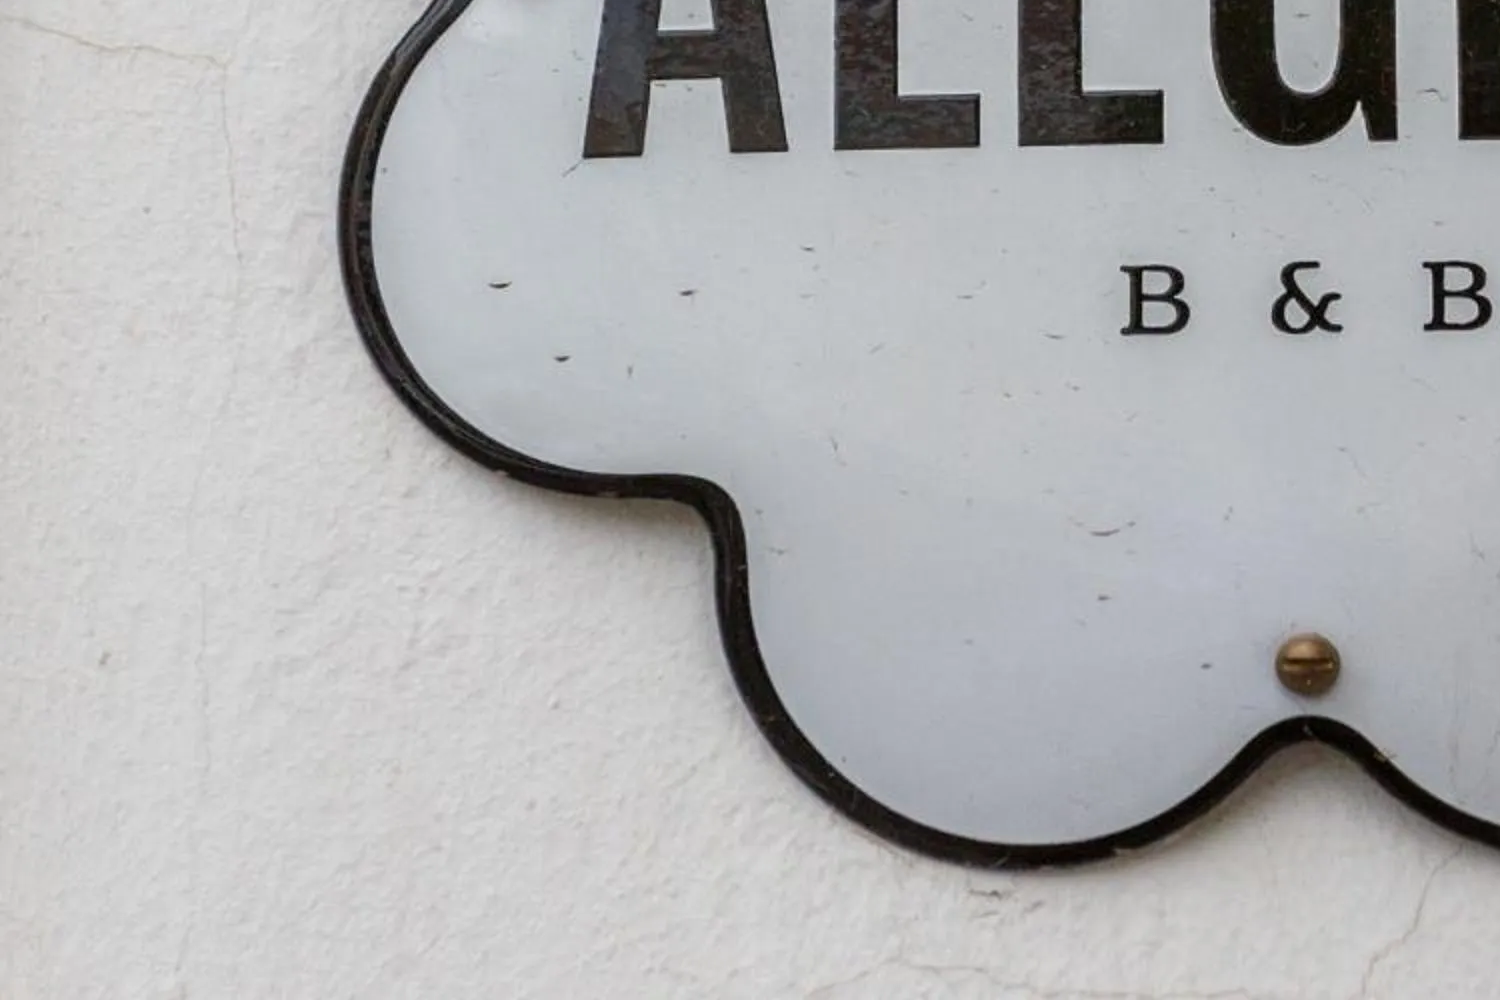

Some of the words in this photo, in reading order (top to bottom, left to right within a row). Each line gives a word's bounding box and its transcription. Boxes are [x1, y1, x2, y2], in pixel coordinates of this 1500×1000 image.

[1119, 263, 1192, 336] B
[1270, 260, 1344, 335] &
[1421, 260, 1494, 332] B
